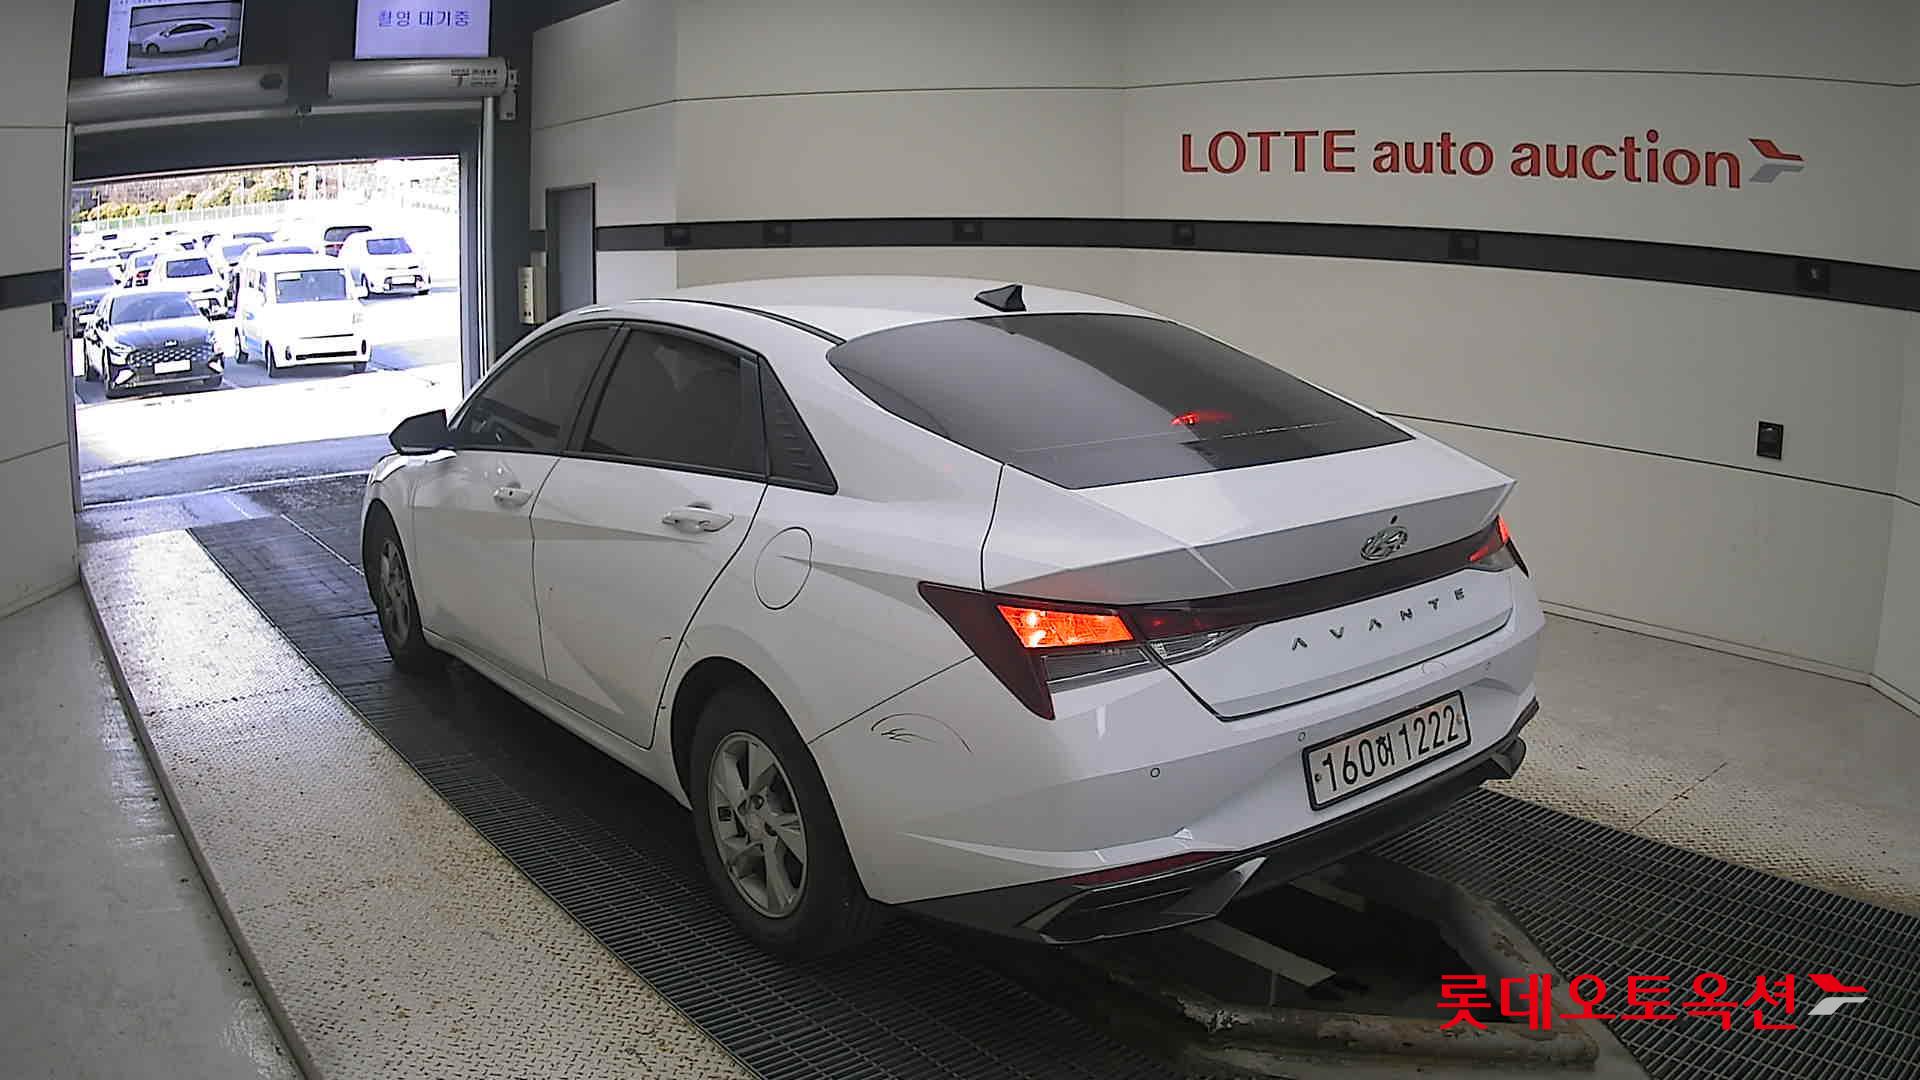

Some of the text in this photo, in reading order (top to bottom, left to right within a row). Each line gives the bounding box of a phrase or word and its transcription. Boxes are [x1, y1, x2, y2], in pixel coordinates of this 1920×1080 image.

[419, 10, 470, 27] 대기중
[1182, 129, 1741, 188] LOTTE auto auction
[1292, 588, 1465, 650] AVANTE
